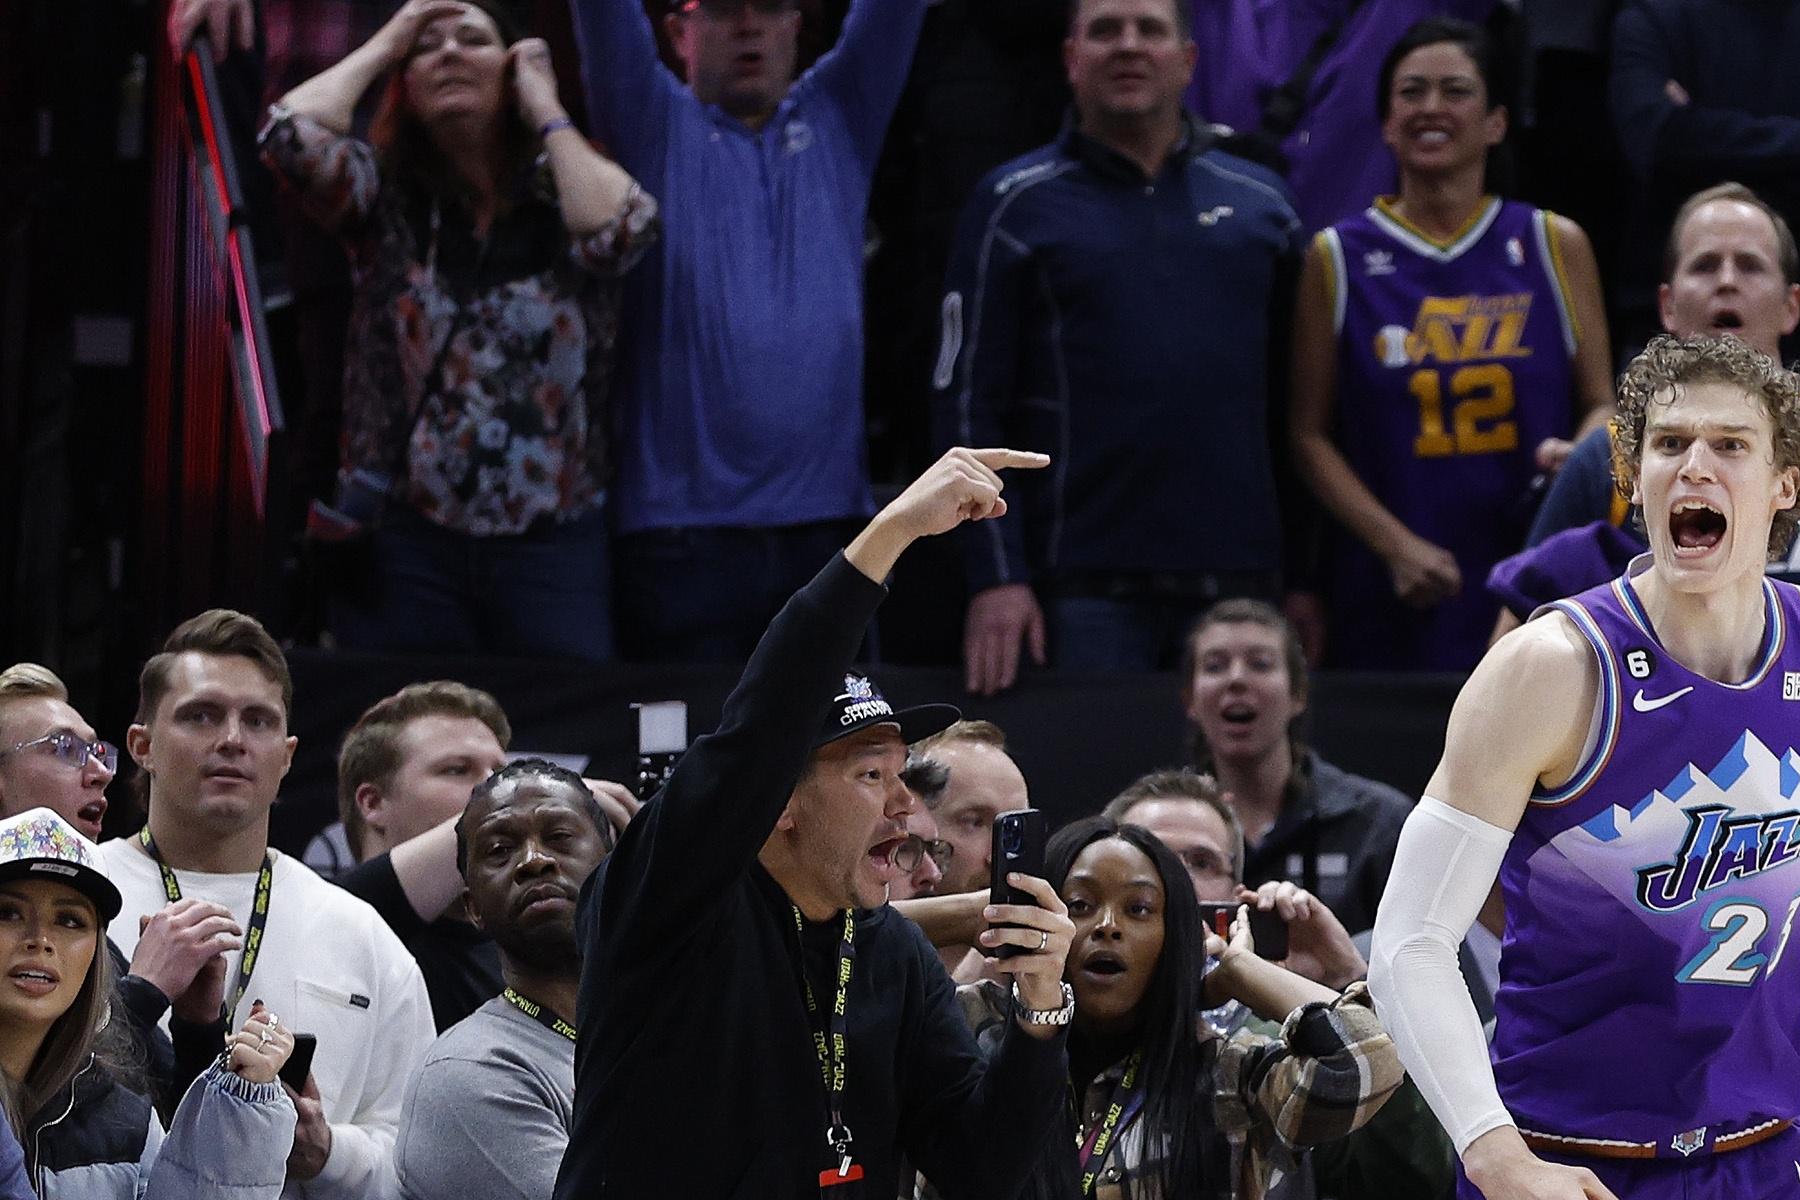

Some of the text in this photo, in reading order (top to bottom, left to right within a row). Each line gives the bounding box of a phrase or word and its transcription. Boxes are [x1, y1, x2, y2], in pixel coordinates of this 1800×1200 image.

[1409, 363, 1519, 459] 12
[1627, 650, 1650, 678] 6
[1785, 675, 1793, 697] 5
[840, 957, 852, 983] UTAH
